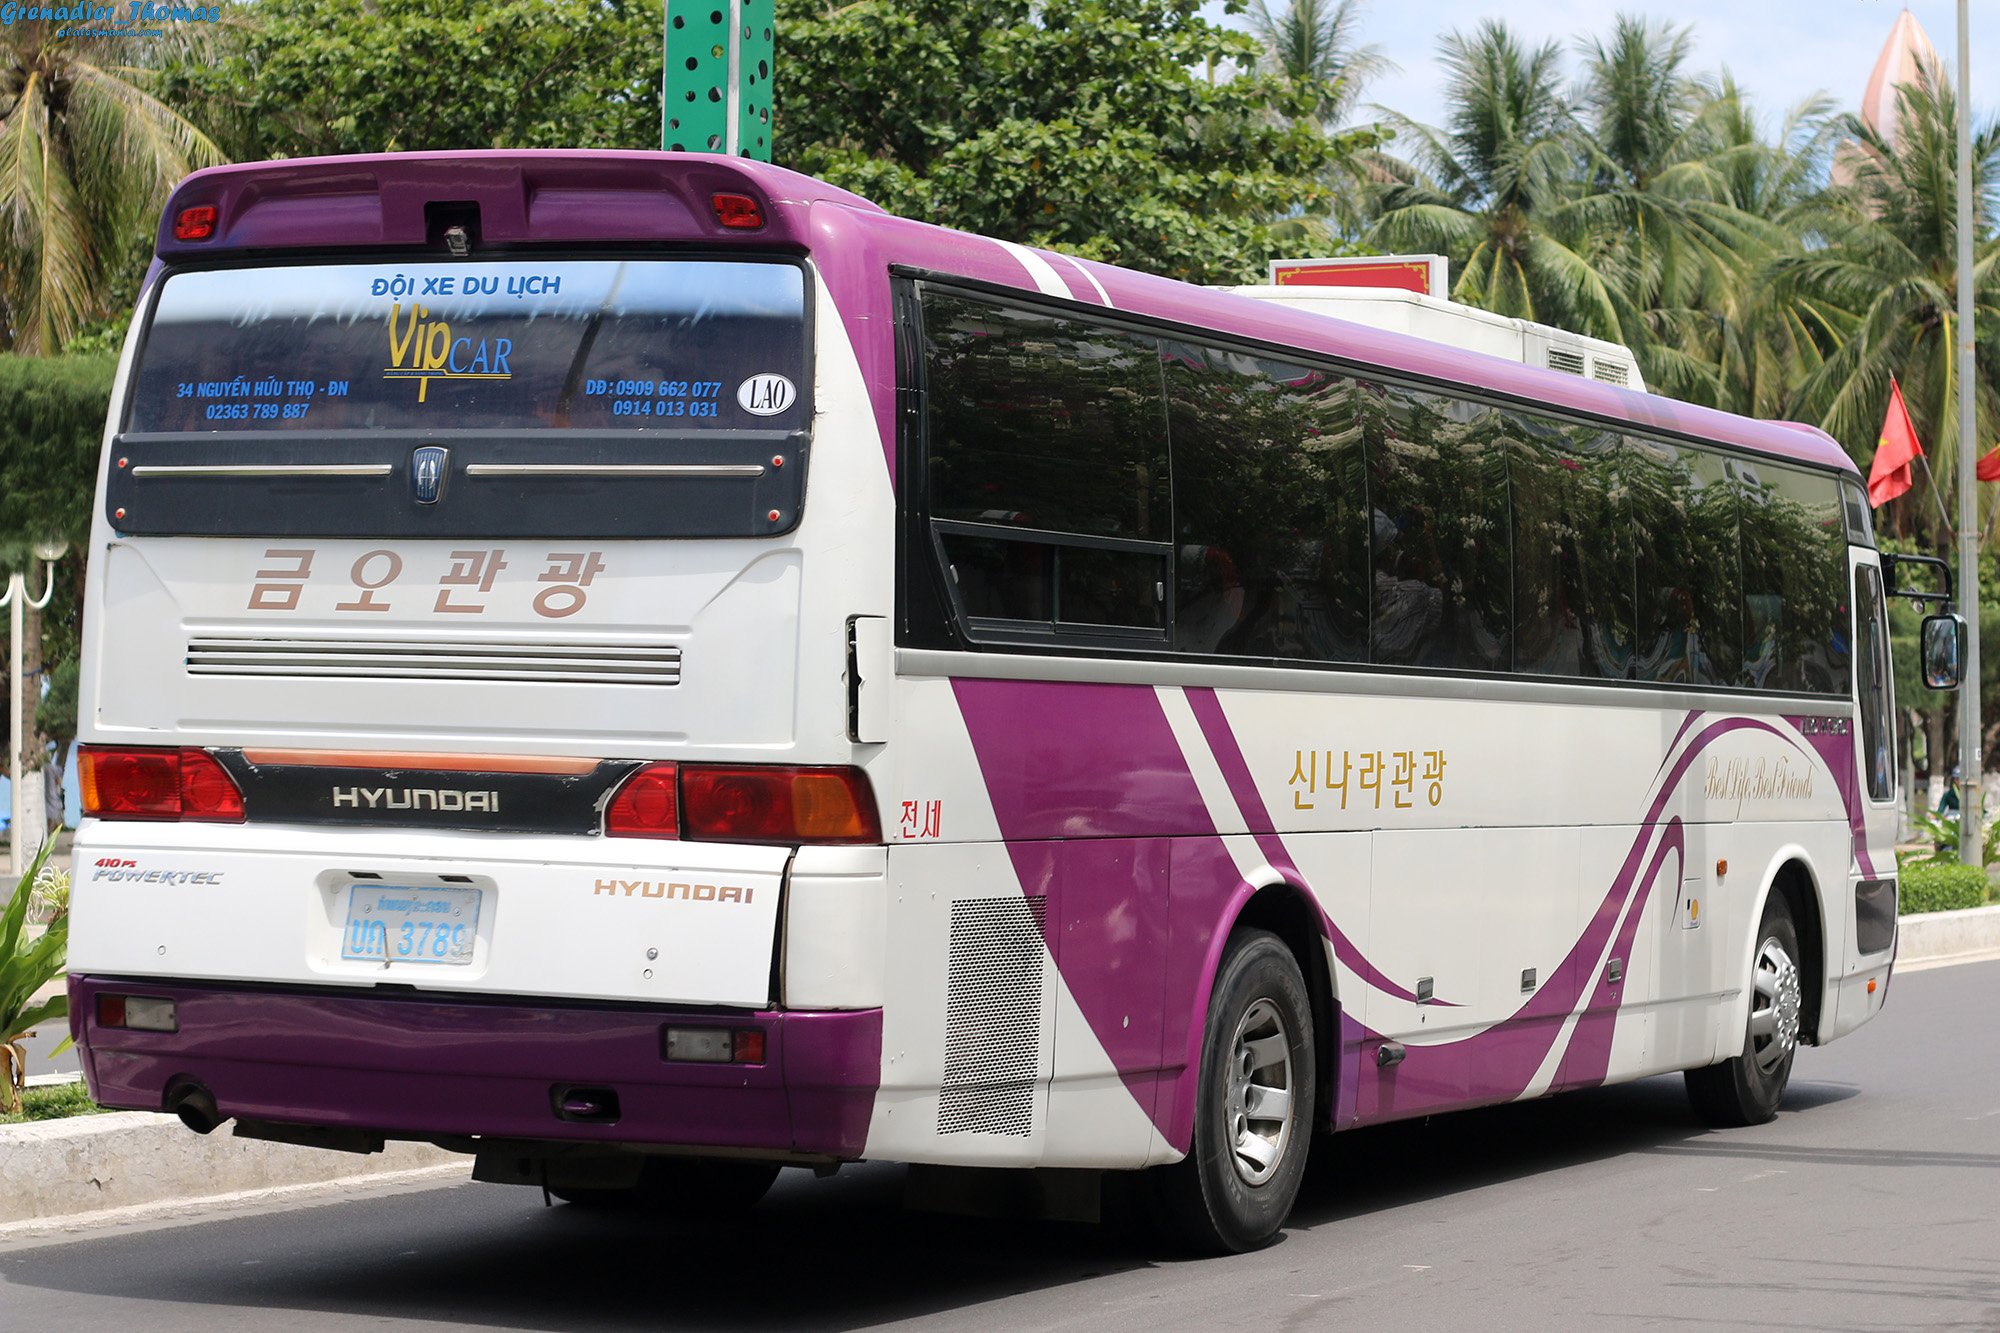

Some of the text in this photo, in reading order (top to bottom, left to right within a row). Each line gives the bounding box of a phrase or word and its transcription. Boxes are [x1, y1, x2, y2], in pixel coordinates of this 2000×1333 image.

[371, 273, 561, 301] ĐỘI XE DU LỊCH
[176, 383, 194, 398] 34
[196, 375, 251, 398] NGUYỄN
[287, 381, 315, 400] THỌ
[327, 381, 349, 396] ĐN
[658, 381, 687, 397] 662
[691, 381, 722, 398] 077
[749, 379, 786, 409] LAO
[206, 403, 310, 419] 02363 789 887
[613, 400, 719, 417] 0914 013 031
[1288, 750, 1447, 810] 신나라관광
[1704, 756, 1732, 799] Best
[1752, 756, 1779, 799] Best
[1778, 756, 1812, 799] Friends
[332, 786, 499, 812] HYUNDAI
[901, 800, 941, 838] 전세
[94, 858, 121, 868] 410
[92, 869, 224, 887] POWERTEC
[594, 879, 754, 904] HYUNDAI
